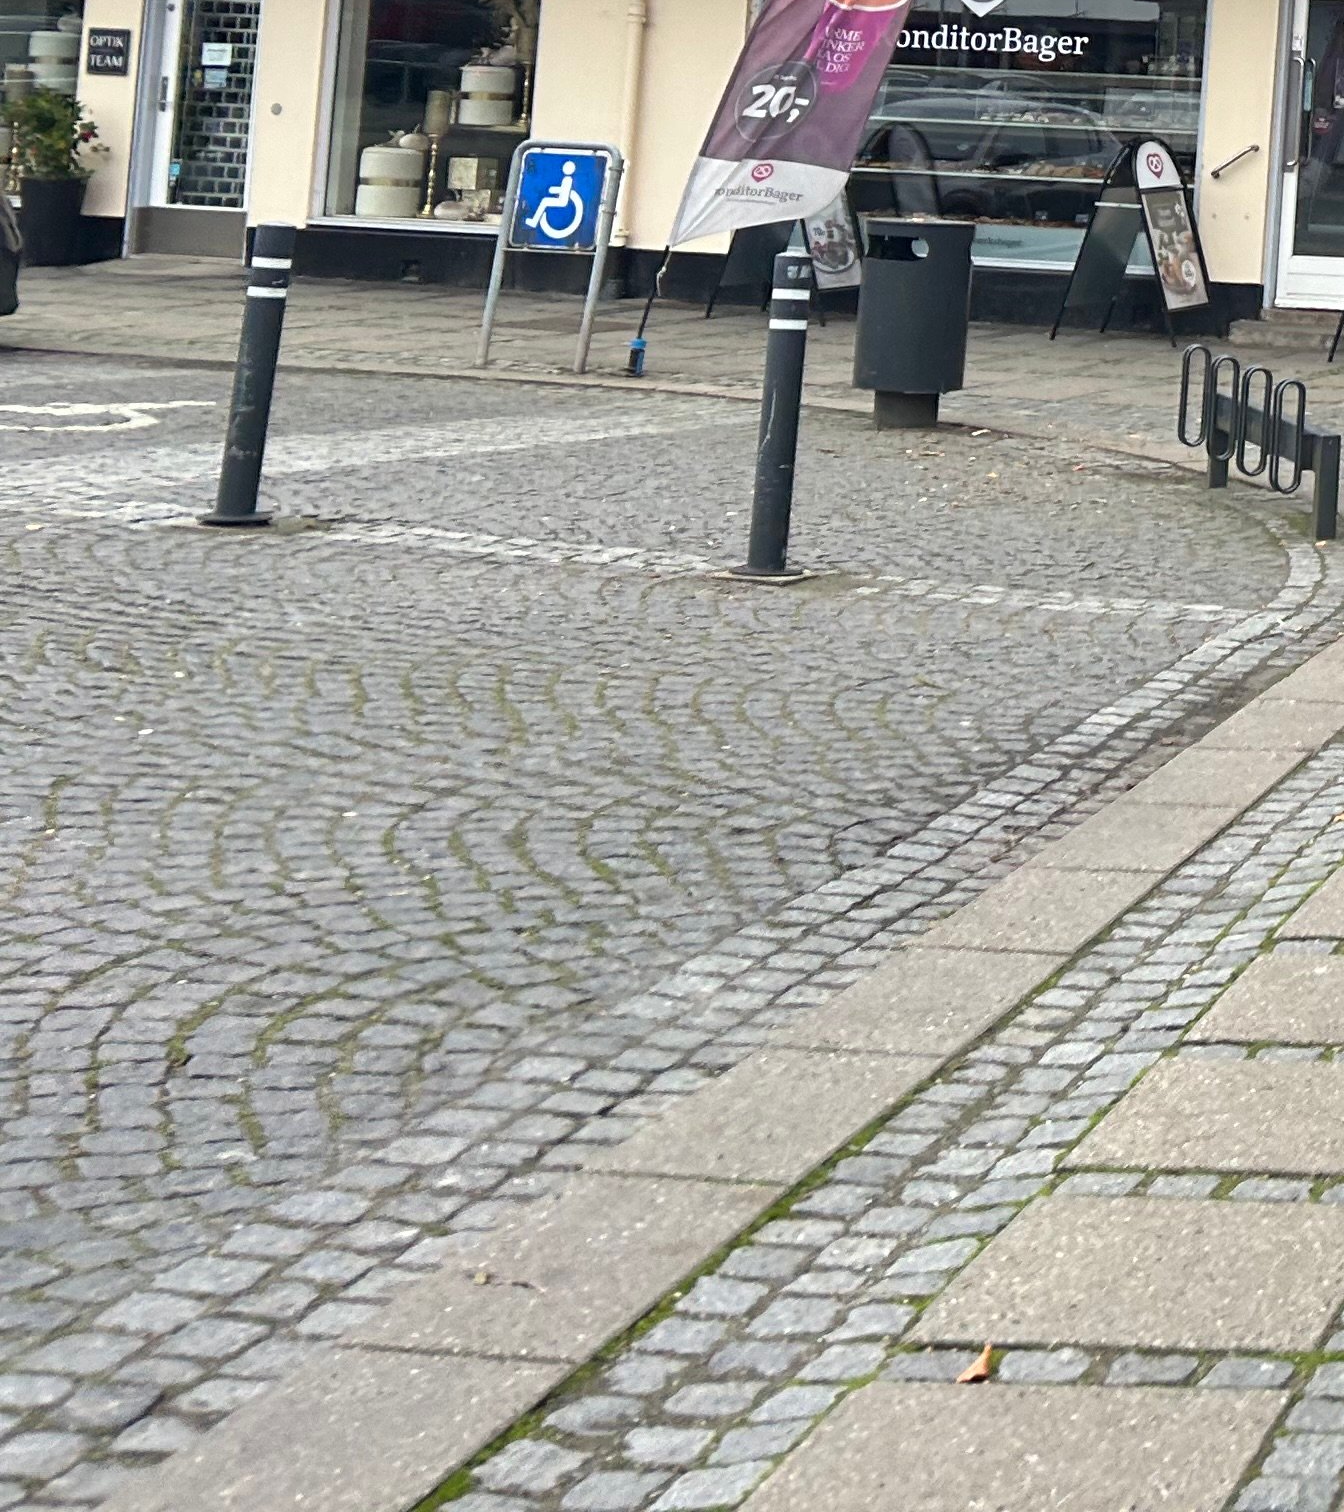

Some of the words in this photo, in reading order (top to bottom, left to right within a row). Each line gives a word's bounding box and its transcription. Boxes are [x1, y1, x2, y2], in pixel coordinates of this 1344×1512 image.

[89, 34, 124, 48] OPTIK
[896, 25, 1089, 62] onditorBager
[90, 54, 123, 68] TEAM
[715, 185, 804, 202] onditorBager
